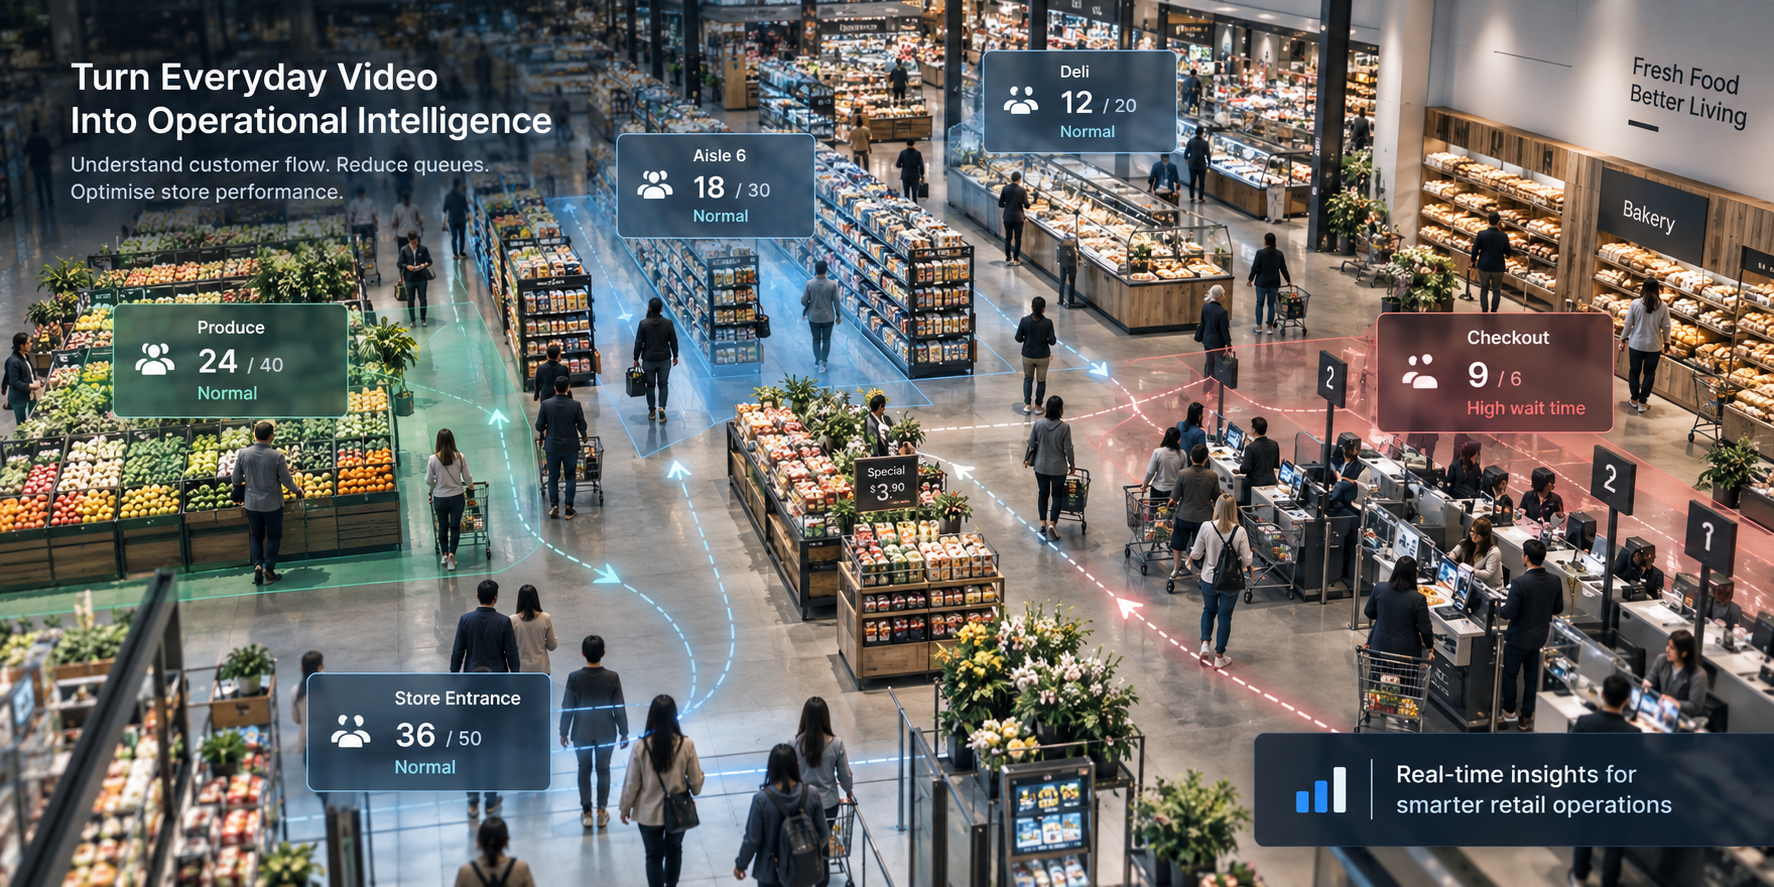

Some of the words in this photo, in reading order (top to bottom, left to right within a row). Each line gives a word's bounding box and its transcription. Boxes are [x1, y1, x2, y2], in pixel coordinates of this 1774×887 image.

[1633, 56, 1684, 85] Fresh
[1690, 67, 1740, 96] Food
[1630, 83, 1685, 112] Better
[1689, 96, 1748, 131] Living
[1623, 199, 1676, 236] Bakery
[1325, 365, 1335, 390] 2
[867, 465, 906, 479] Special
[1603, 463, 1617, 494] 2
